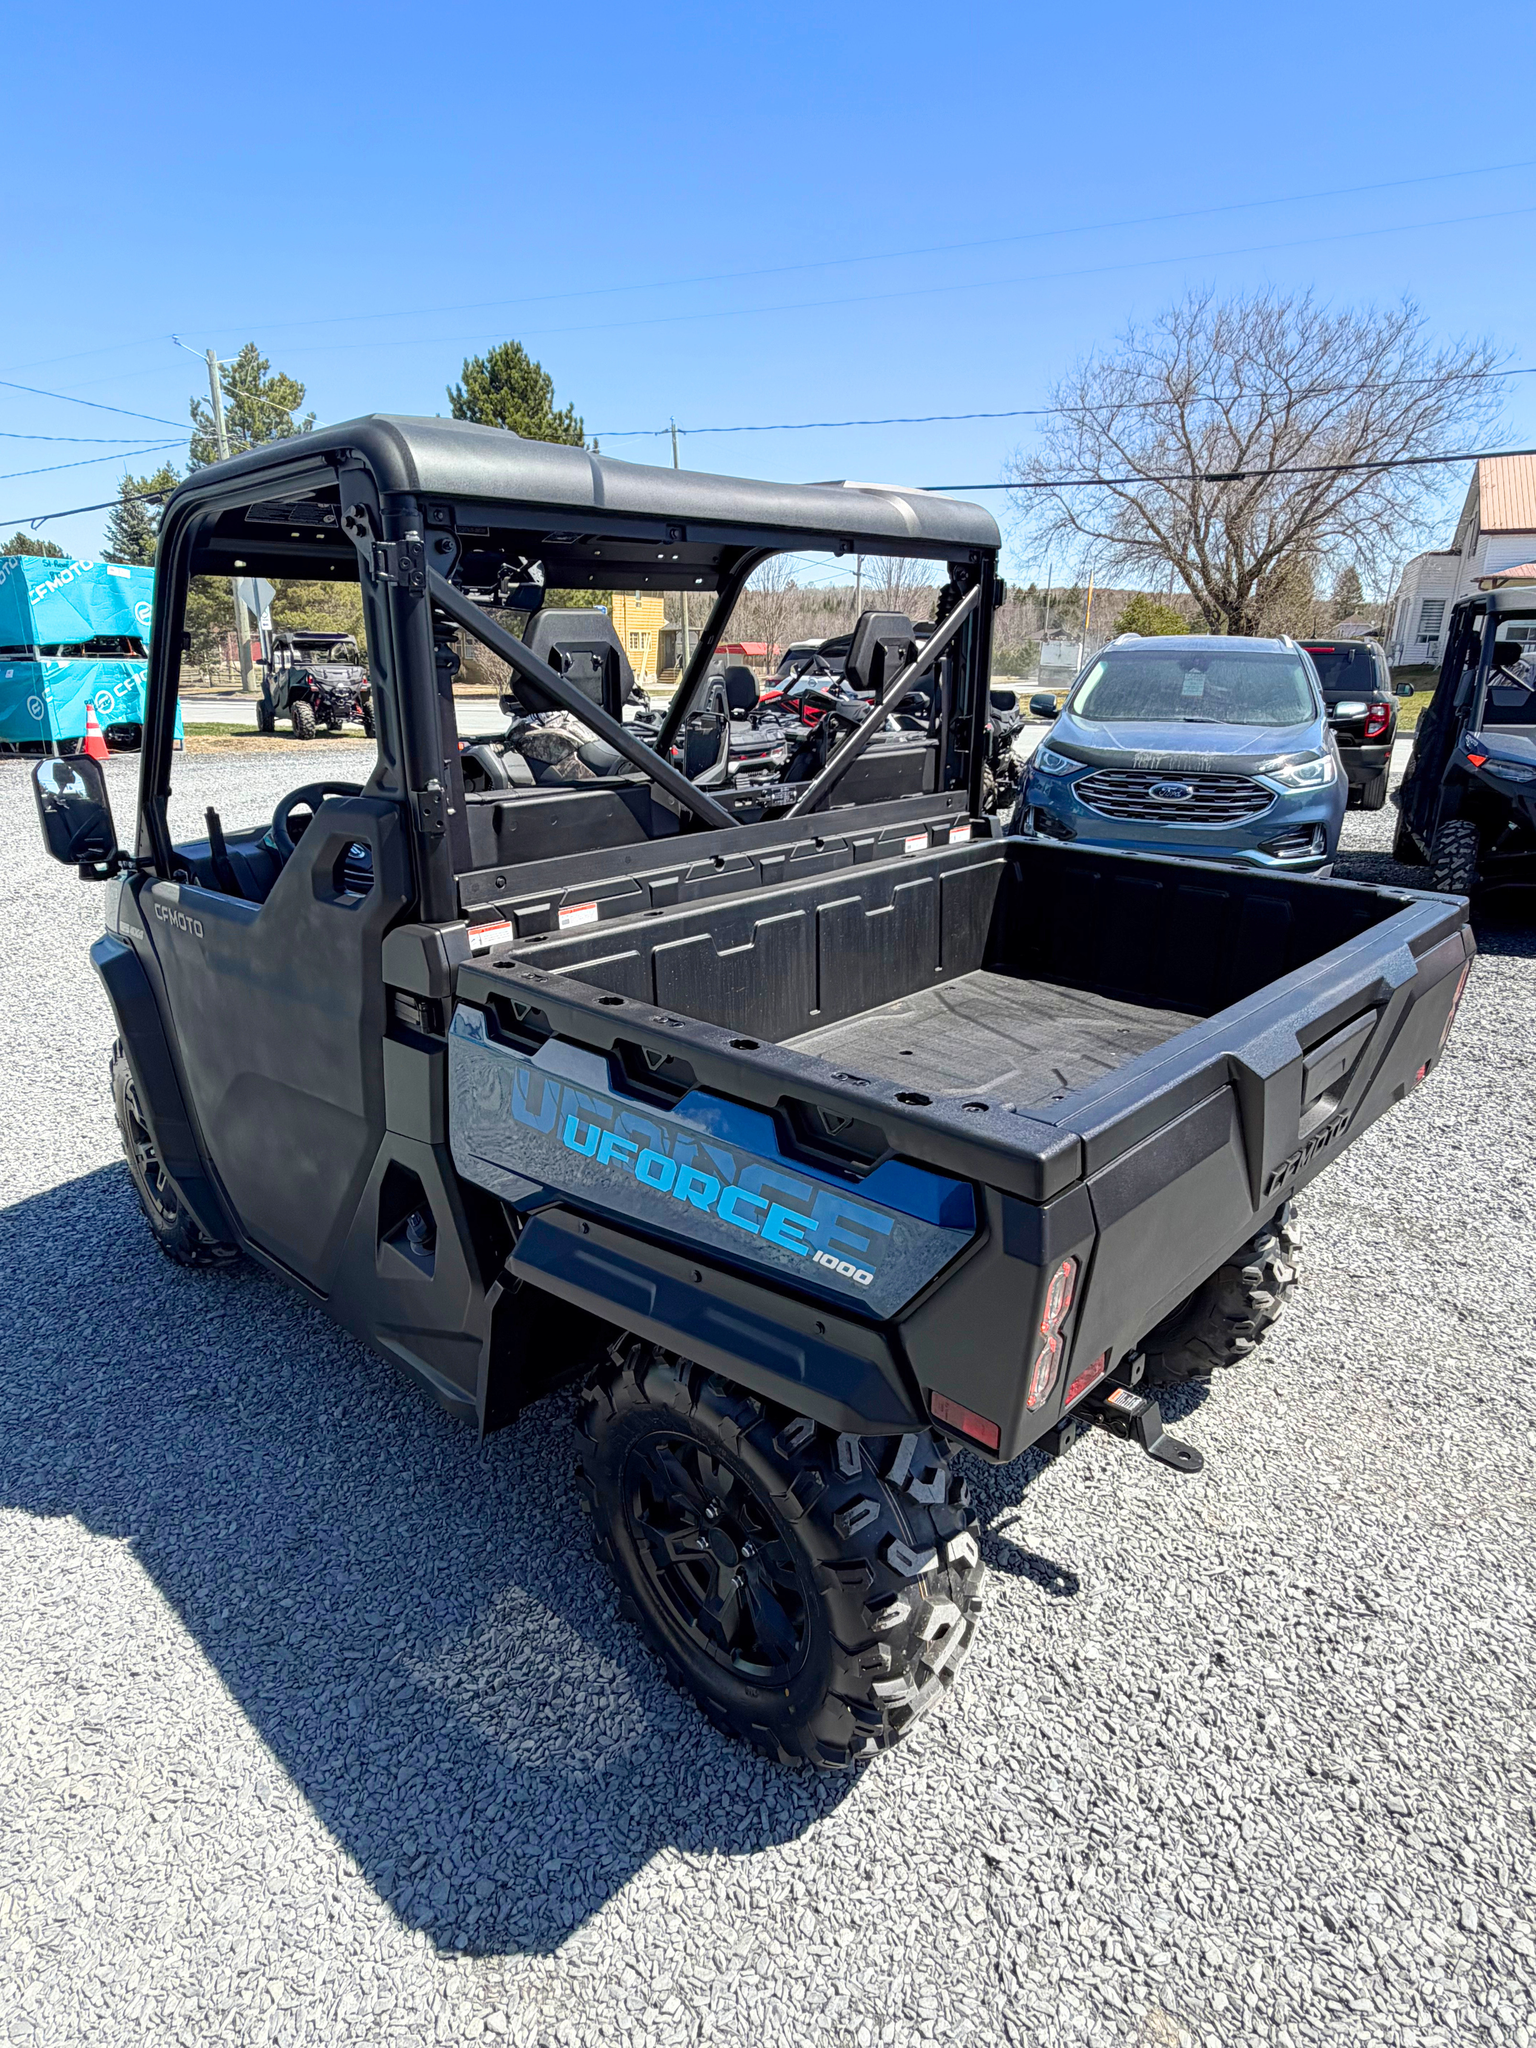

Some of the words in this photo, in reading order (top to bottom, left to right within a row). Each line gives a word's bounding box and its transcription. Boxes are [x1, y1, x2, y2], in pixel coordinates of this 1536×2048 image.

[28, 559, 94, 606] CFMOTO
[154, 902, 204, 938] CFMOTO
[1263, 1107, 1352, 1198] CFMOTO
[562, 1113, 820, 1257] UFORCE
[812, 1249, 875, 1287] 1000
